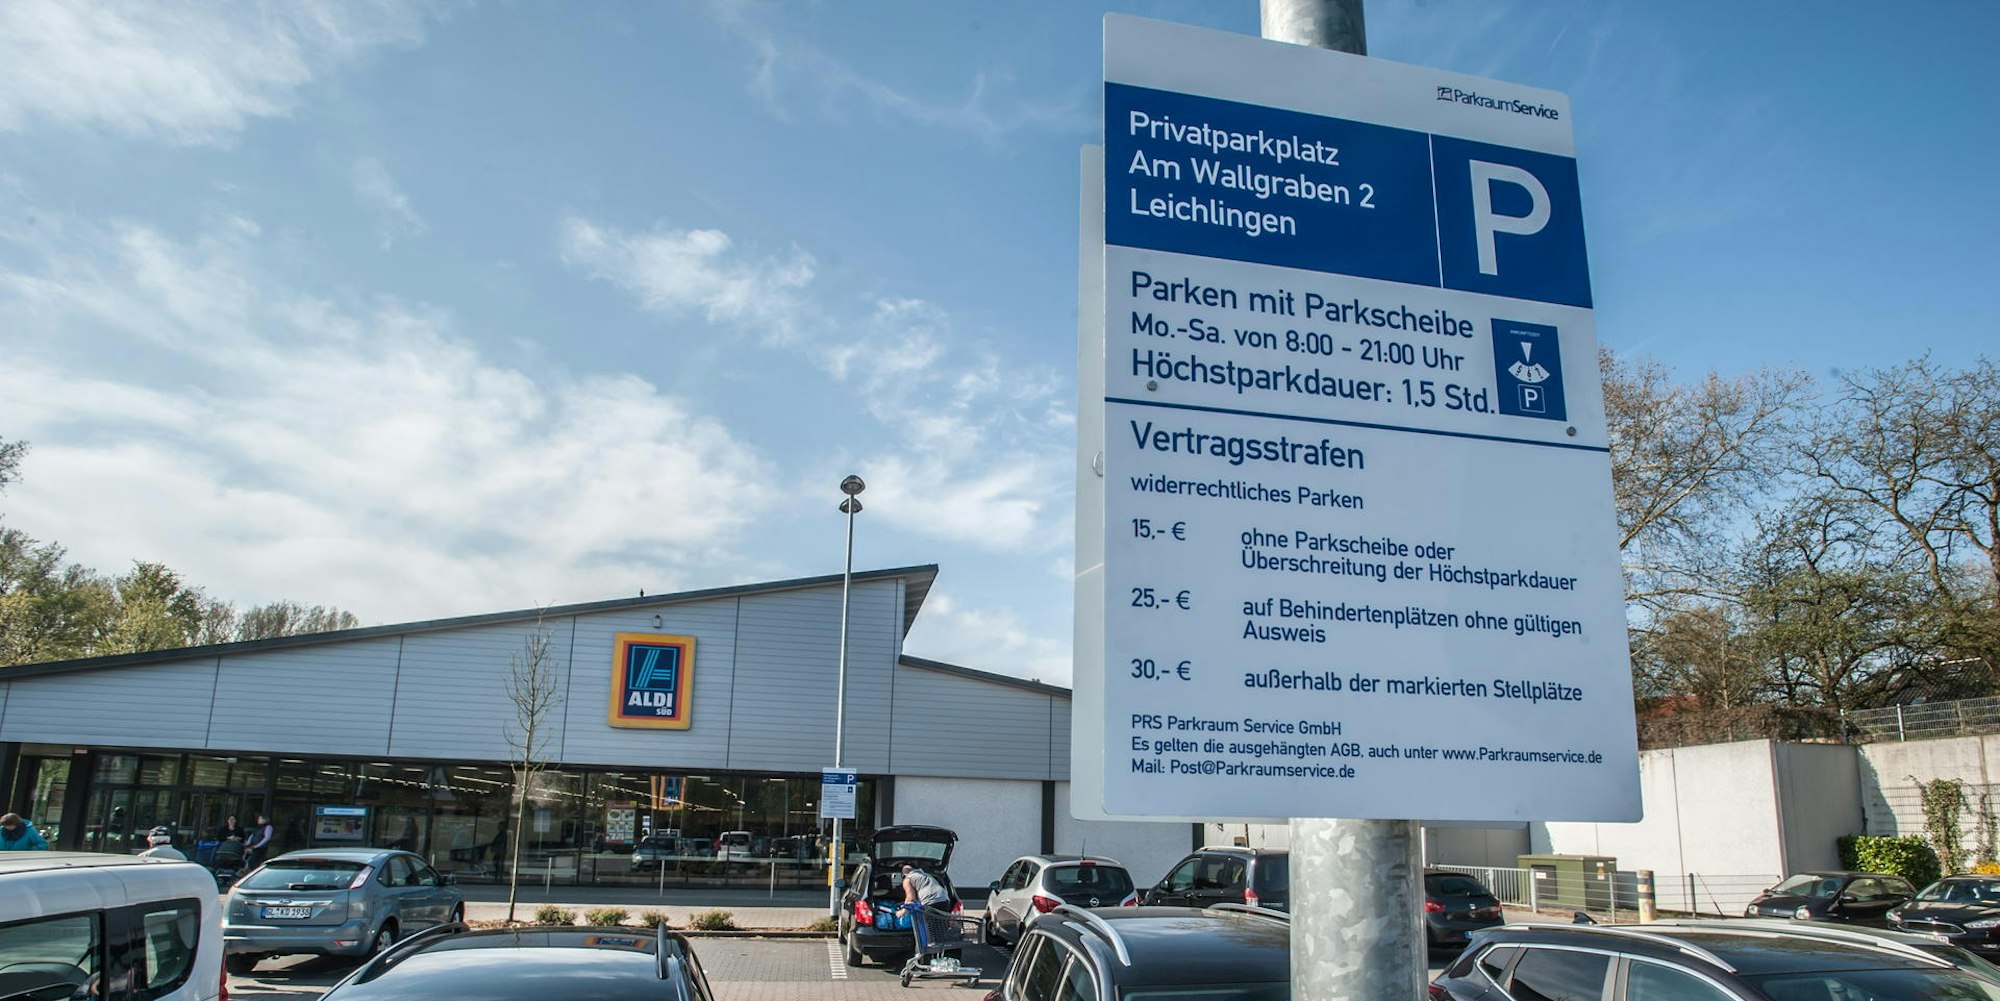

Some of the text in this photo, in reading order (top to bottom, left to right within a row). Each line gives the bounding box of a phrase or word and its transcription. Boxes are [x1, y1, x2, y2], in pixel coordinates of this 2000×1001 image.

[1454, 89, 1559, 120] ParkraumService
[1131, 111, 1339, 165] Privatparkplatz
[1129, 150, 1374, 208] Am Wallgraben 2
[1131, 188, 1295, 236] Leichlingen
[1470, 160, 1550, 275] P
[1132, 271, 1473, 338] Parken mit Parkscheibe
[1132, 311, 1225, 344] Mo.-Sa.
[1234, 329, 1277, 350] von
[1286, 330, 1333, 356] 8:00
[1360, 339, 1415, 365] 21:00
[1422, 346, 1464, 371] Uhr
[1133, 348, 1495, 414] Höchstparkdauer: 1,5 Std.
[1524, 388, 1538, 408] P
[1130, 420, 1364, 469] Vertragsstrafen
[1131, 473, 1363, 509] widerrechtliches Parken
[1132, 518, 1186, 541] 15,- €
[1241, 527, 1455, 560] ohne Parkscheibe oder
[1242, 546, 1577, 590] Überschreitung der Höchstparkdauer
[1132, 587, 1190, 610] 25,- €
[1243, 598, 1582, 638] auf Behindertenplätzen ohne gültigen
[1243, 620, 1326, 643] Ausweis
[1131, 659, 1191, 681] 30,- €
[1244, 669, 1582, 704] außerhalb der markierten Stellplätze
[628, 691, 673, 707] ALDI
[656, 707, 672, 716] SÜD
[1132, 714, 1341, 735] PRS Parkraum Service GmbH
[1132, 736, 1149, 751] Es
[1154, 738, 1198, 755] gelten
[1204, 739, 1224, 753] die
[1229, 741, 1326, 759] ausgehängten
[1368, 744, 1399, 758] auch
[1404, 746, 1439, 759] unter
[1442, 747, 1602, 764] www.Parkraumservice.de
[847, 774, 855, 784] P
[1132, 758, 1355, 778] Mail: Post@Parkraumservice.de
